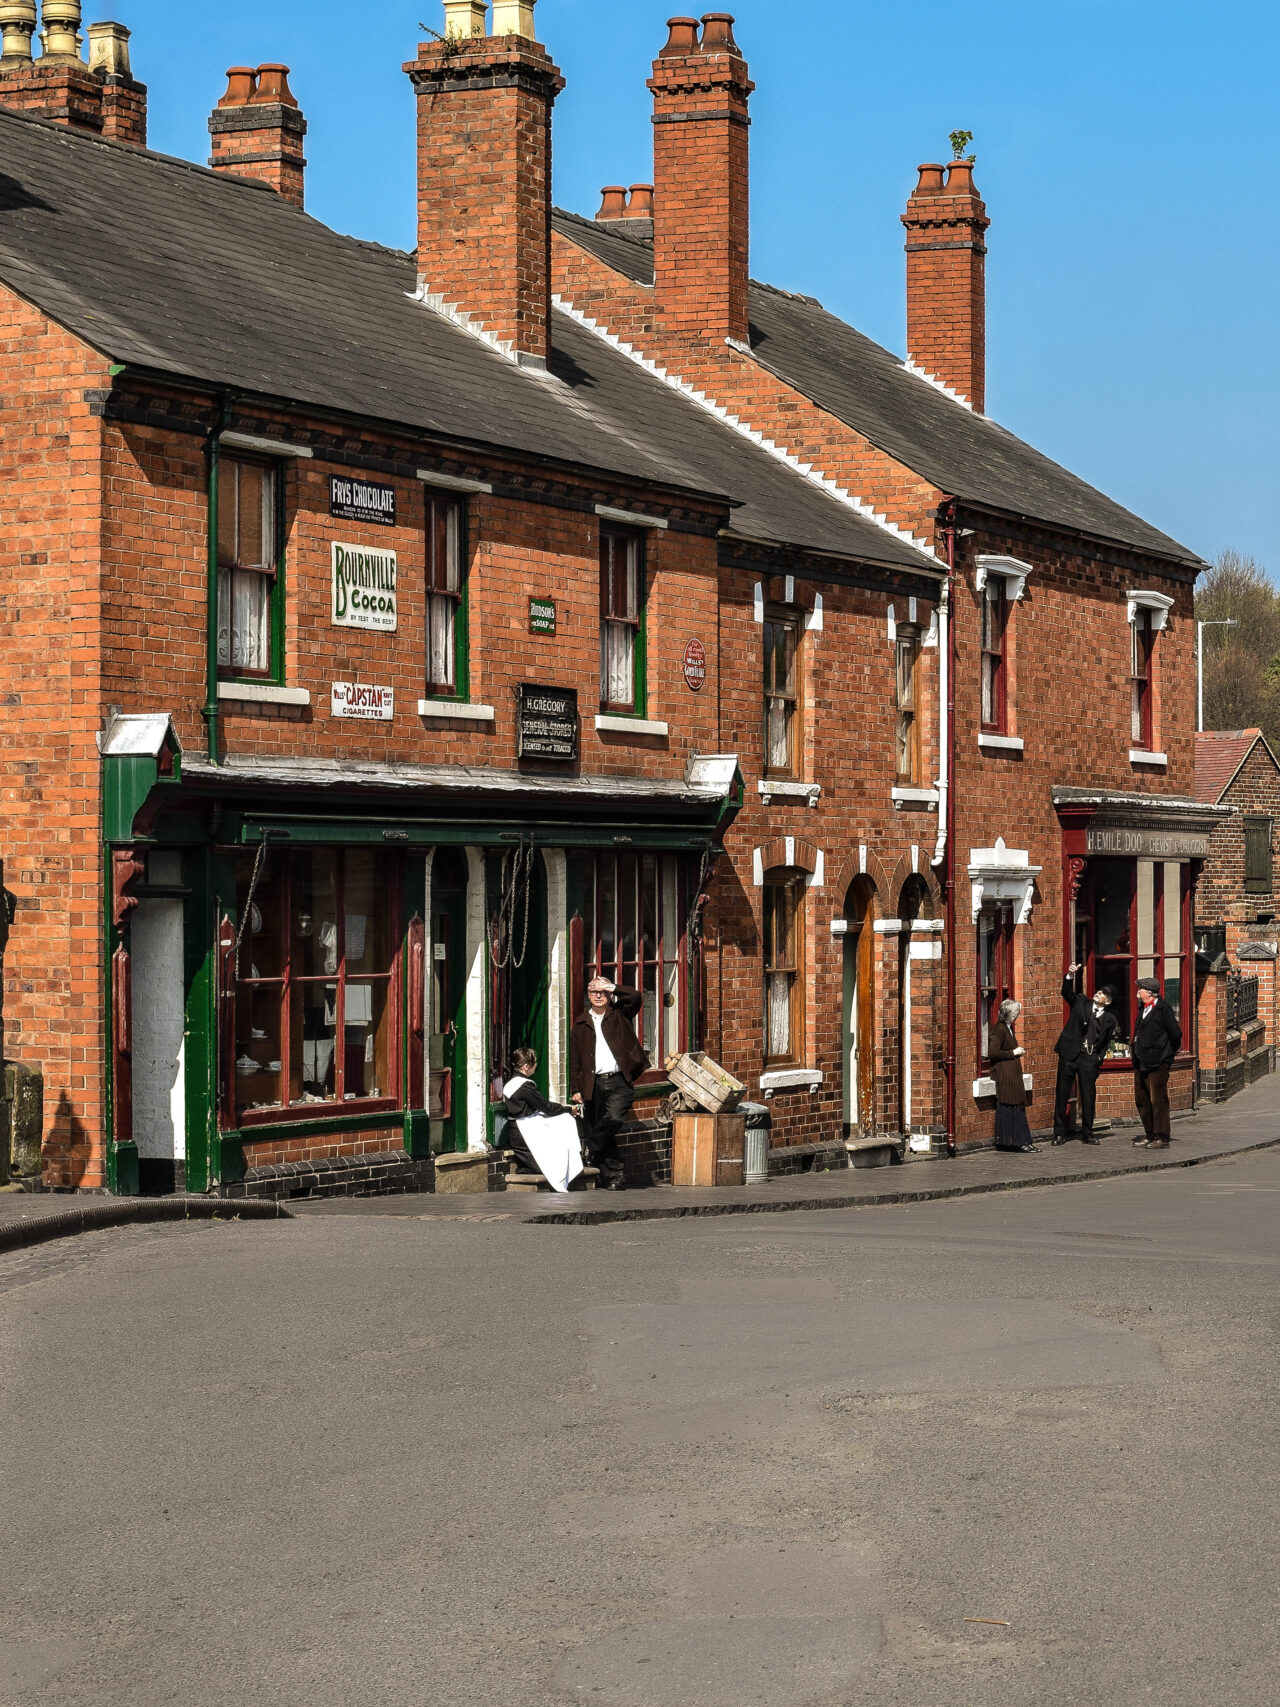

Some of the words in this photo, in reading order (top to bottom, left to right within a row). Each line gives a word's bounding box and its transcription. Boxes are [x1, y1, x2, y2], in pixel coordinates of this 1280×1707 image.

[332, 479, 351, 505] FRY'S
[352, 482, 394, 512] CHOCOLATE
[335, 545, 395, 617] BOURNVILLE
[351, 589, 394, 613] COCOA
[536, 620, 549, 628] SOAP
[342, 707, 383, 717] CIGARETTES
[553, 744, 571, 753] TOBACCO
[1125, 833, 1142, 852] DOO
[1149, 837, 1173, 852] CHEMIST
[1180, 839, 1207, 854] DRUGGIST
